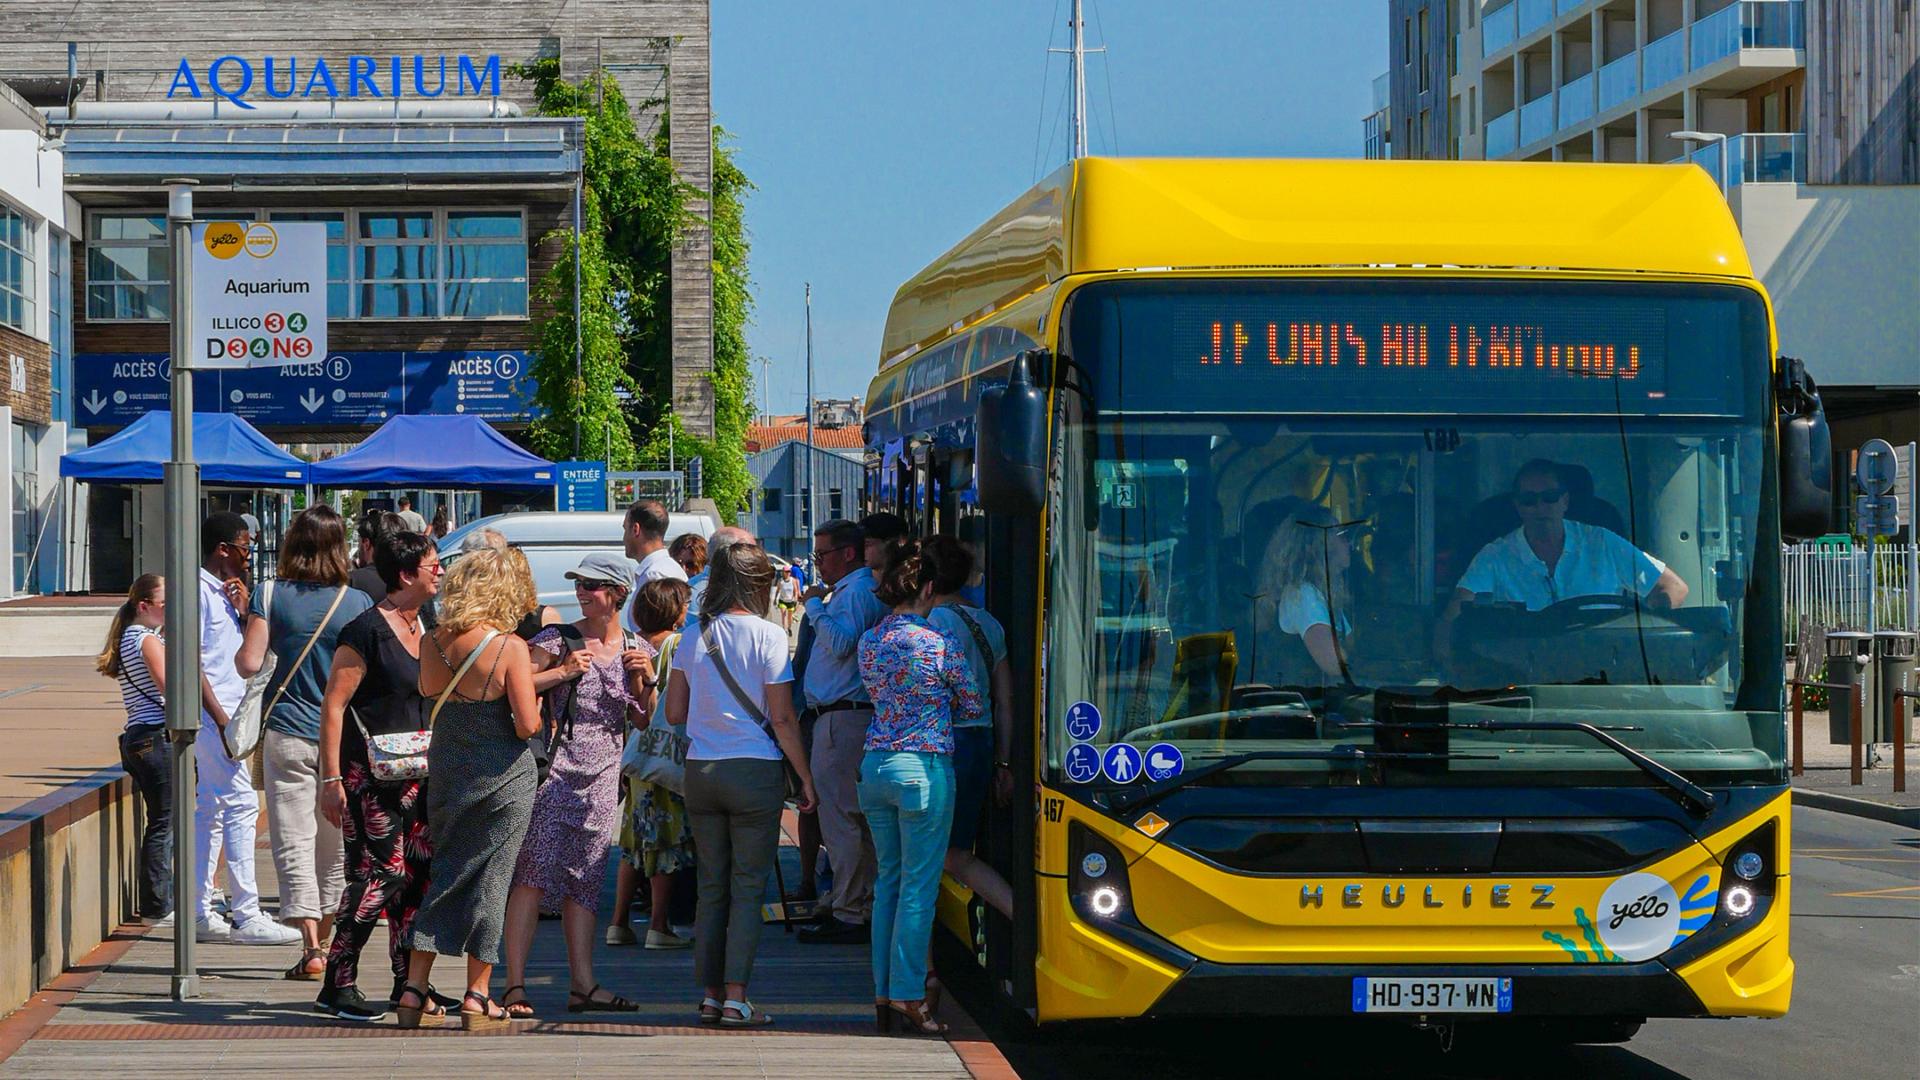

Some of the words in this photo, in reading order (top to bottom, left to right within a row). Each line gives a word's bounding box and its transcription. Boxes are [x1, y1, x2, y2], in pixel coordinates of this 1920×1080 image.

[167, 54, 501, 110] AQUARIUM
[211, 233, 238, 249] yélo
[225, 279, 310, 297] Aquarium
[212, 318, 261, 330] ILLICO
[113, 359, 156, 378] ACCÈS
[448, 356, 492, 375] ACCÈS
[563, 468, 601, 479] ENTRÉE
[1044, 798, 1065, 823] 467
[1299, 884, 1557, 909] HEULIEZ
[1610, 895, 1669, 929] yélo
[1372, 983, 1494, 1007] HD-937-WN
[1499, 996, 1511, 1008] 17
